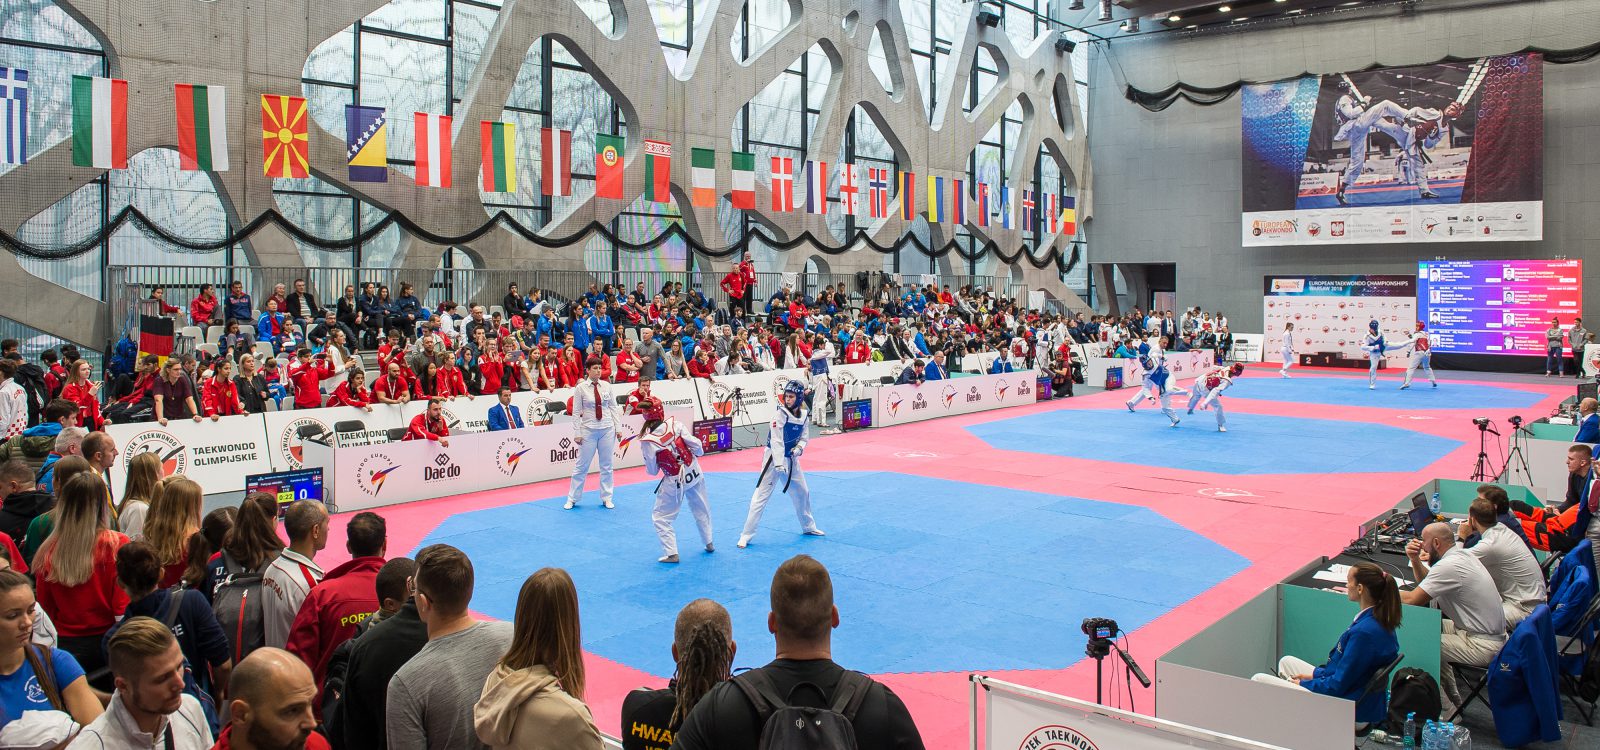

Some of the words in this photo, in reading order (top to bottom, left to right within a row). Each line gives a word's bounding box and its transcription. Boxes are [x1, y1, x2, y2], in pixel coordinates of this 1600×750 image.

[139, 433, 178, 447] TAEKWONDO
[340, 430, 388, 440] TAEKWOND
[702, 434, 706, 443] 2
[720, 432, 724, 440] 0
[193, 442, 256, 455] TAEKWONDO
[194, 453, 257, 466] OLIMPIJSKIE
[371, 454, 392, 465] EUROPE
[300, 489, 307, 500] 0
[263, 578, 283, 600] ORTUGAL
[341, 612, 372, 626] PORT
[632, 722, 673, 745] HWA
[1045, 730, 1094, 750] TAEKWO
